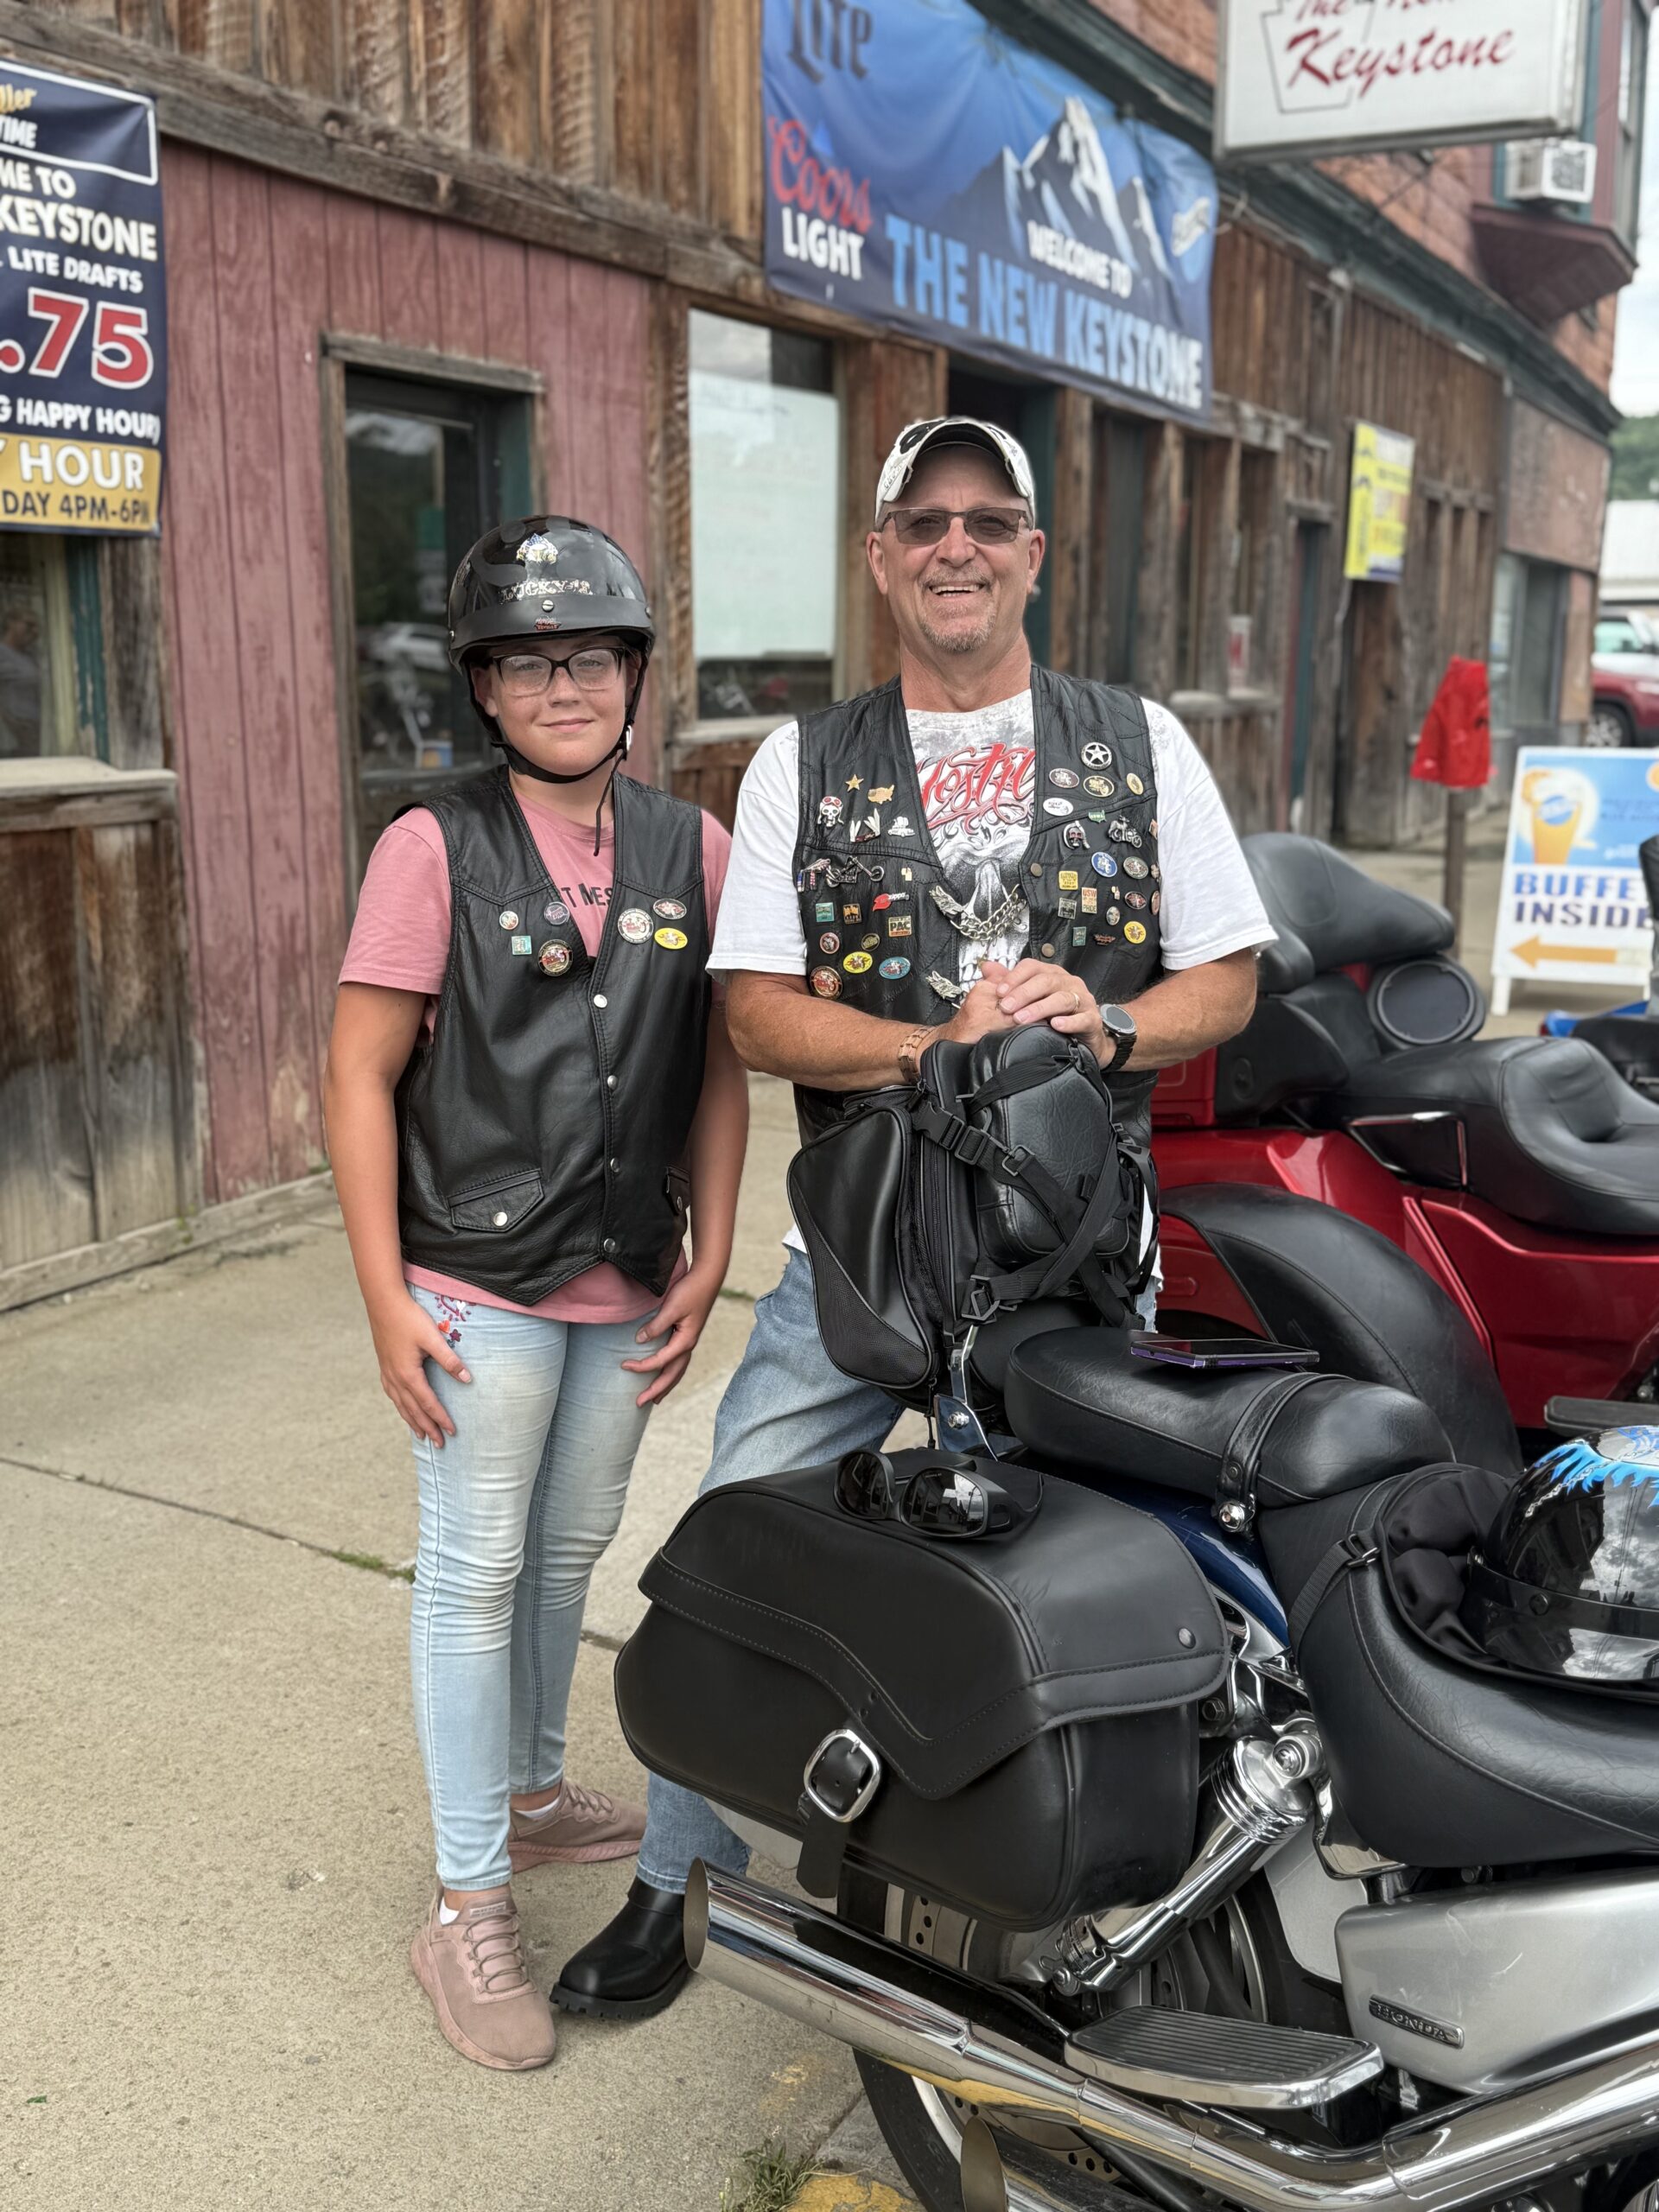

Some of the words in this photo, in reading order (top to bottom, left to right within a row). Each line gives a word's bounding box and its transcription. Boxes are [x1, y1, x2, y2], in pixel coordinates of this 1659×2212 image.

[1286, 27, 1514, 99] Keystone
[35, 166, 76, 199] TO
[767, 116, 873, 234] Coors
[0, 194, 157, 261] KEYSTONE
[781, 206, 865, 281] LIGHT
[1027, 219, 1111, 290] WELCOME
[1109, 257, 1134, 299] TO
[7, 245, 60, 276] LITE
[63, 256, 144, 294] DRAFTS
[886, 213, 969, 328] THE
[978, 252, 1058, 359] NEW
[1065, 289, 1203, 410] KEYSTONE
[16, 397, 92, 431] HAPPY
[19, 441, 145, 493] HOUR
